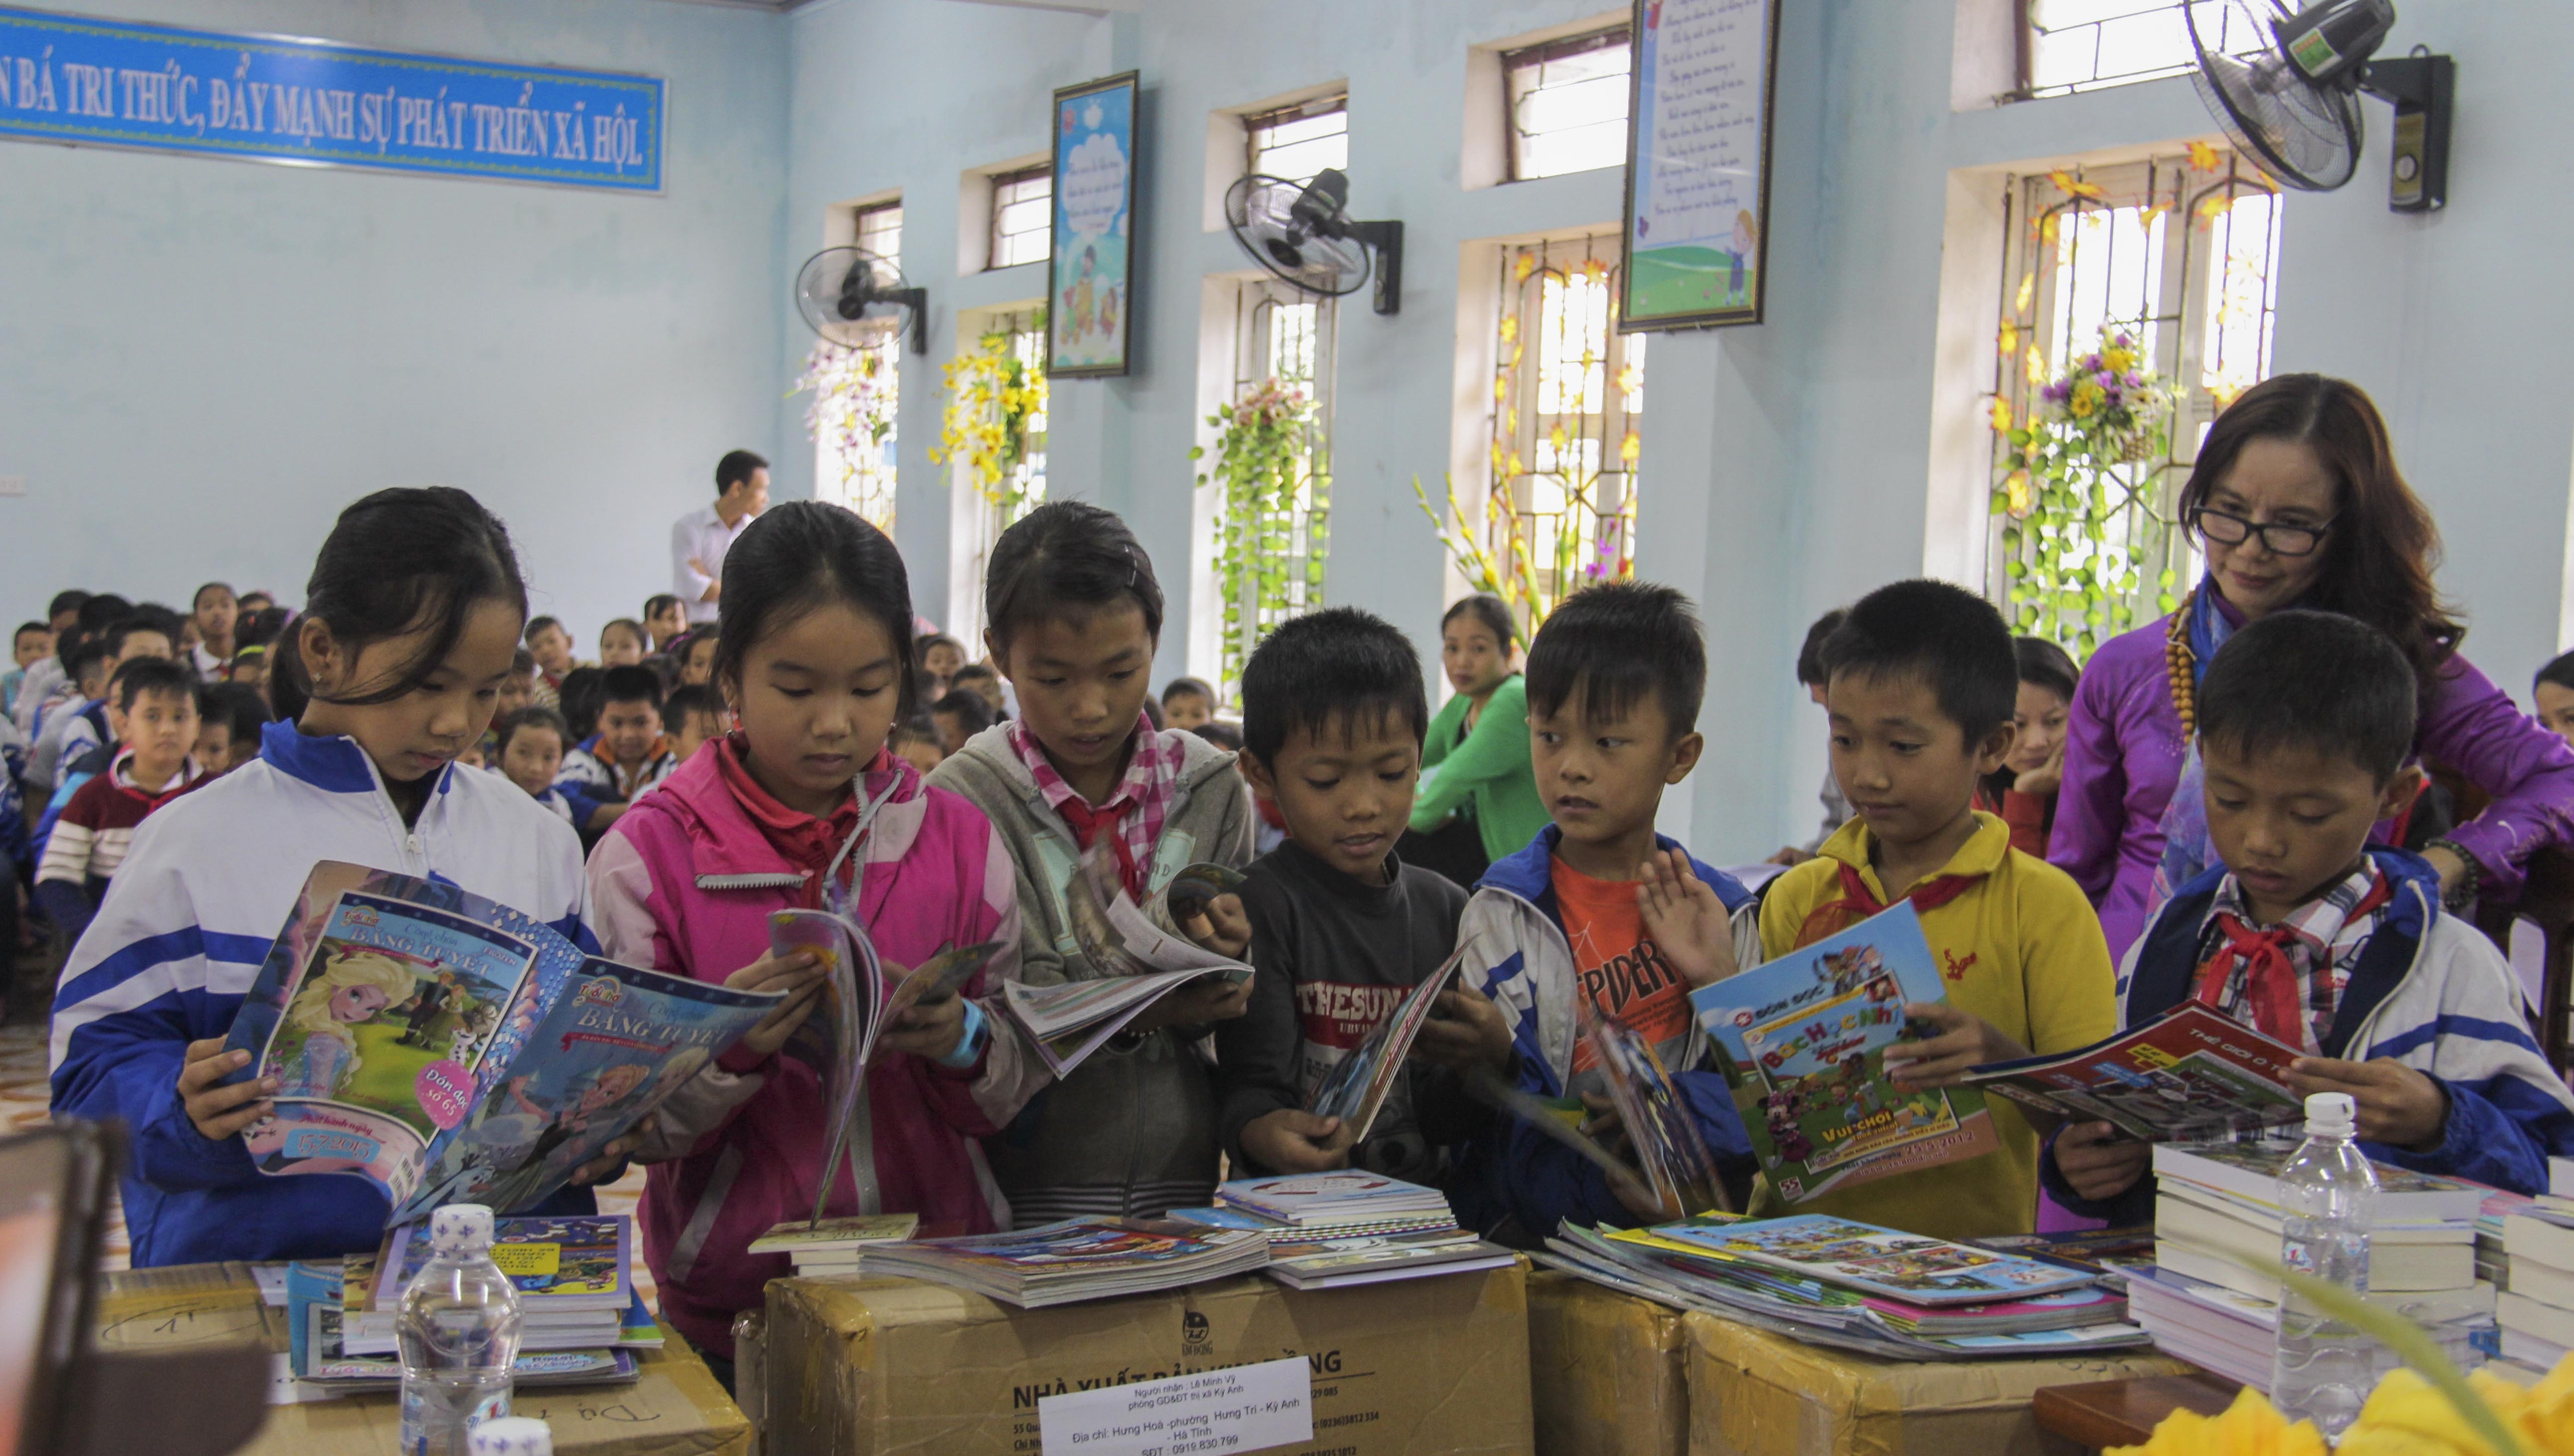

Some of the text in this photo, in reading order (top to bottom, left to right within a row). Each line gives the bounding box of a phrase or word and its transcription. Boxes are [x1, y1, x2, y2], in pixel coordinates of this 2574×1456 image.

[16, 44, 58, 112] BÁ
[63, 63, 114, 117] TRI
[210, 51, 269, 132] ĐẨY
[273, 84, 356, 147] MẠNH
[360, 85, 395, 155] SỰ
[397, 85, 468, 149] PHÁT
[471, 81, 549, 156] TRIỂN
[553, 101, 587, 161] XÃ
[351, 926, 415, 950] BĂNG
[1577, 940, 1678, 1016] PIDER
[577, 1007, 653, 1037] BĂNG
[425, 1068, 454, 1092] Đón
[428, 1088, 458, 1116] số 65
[1202, 1377, 1222, 1387] Minh
[1073, 1432, 1089, 1444] Địa
[1113, 1425, 1140, 1438] Hưng
[1214, 1410, 1241, 1421] Hưng
[1281, 1398, 1300, 1410] Anh
